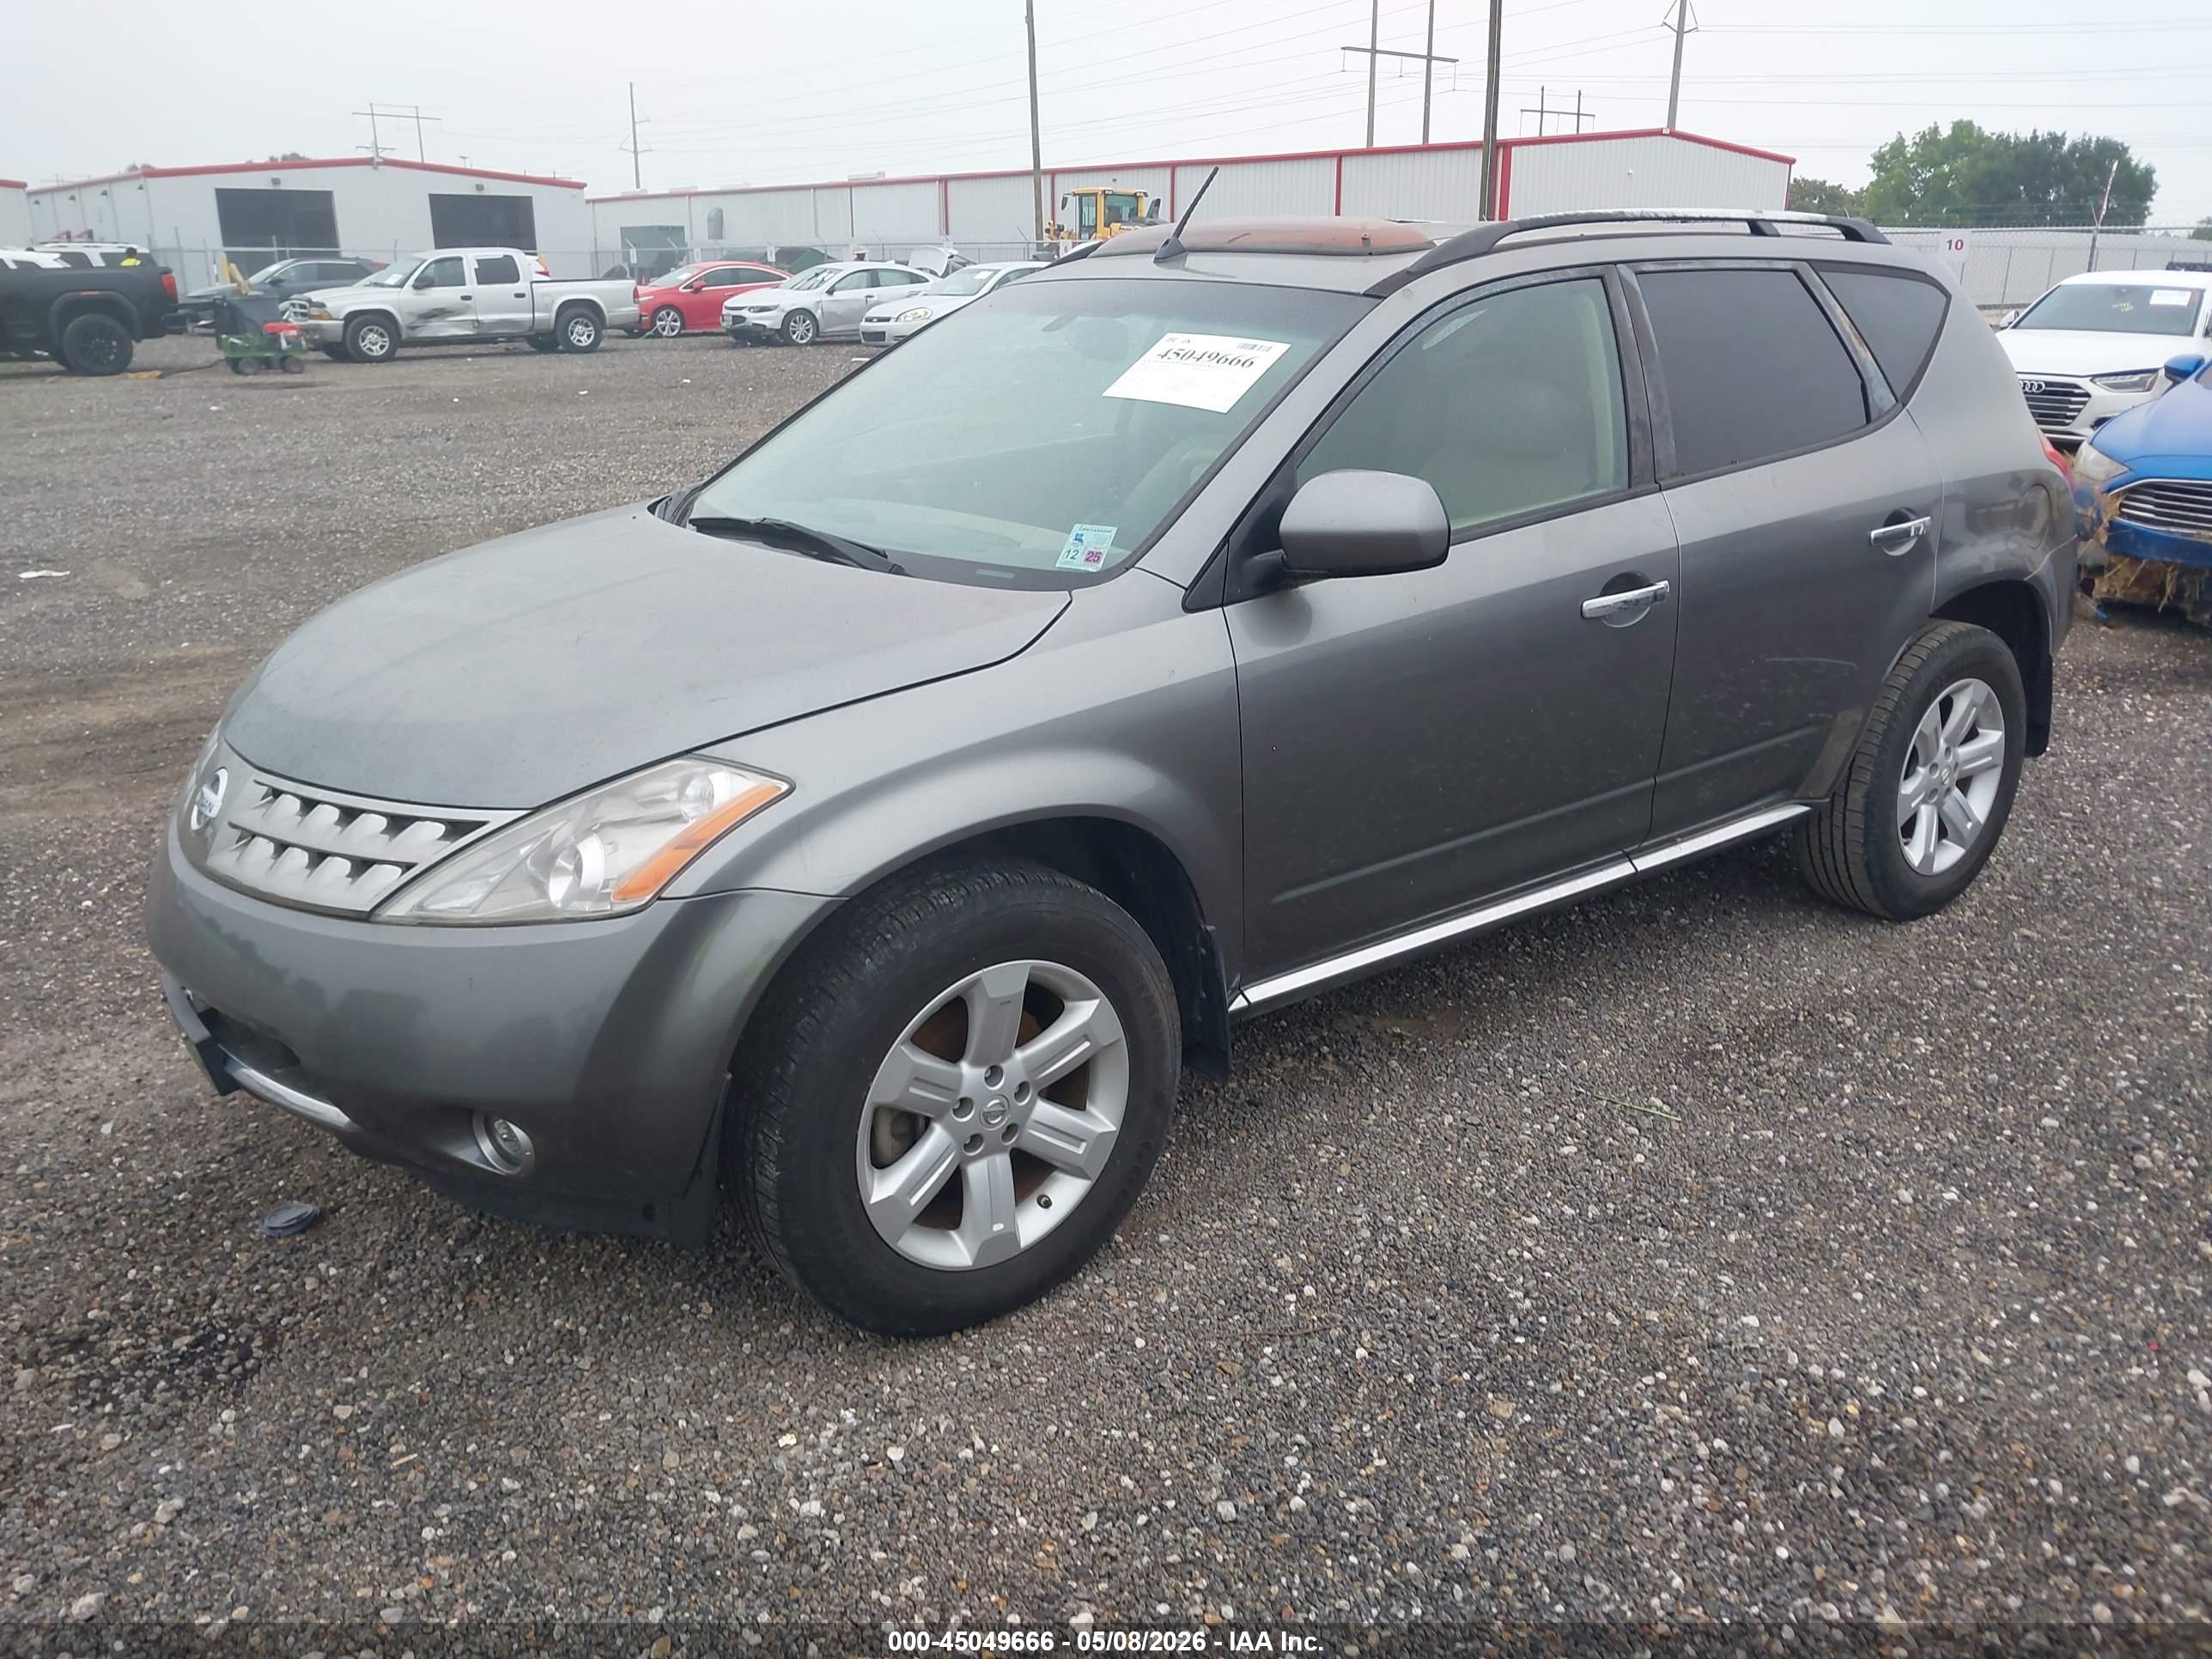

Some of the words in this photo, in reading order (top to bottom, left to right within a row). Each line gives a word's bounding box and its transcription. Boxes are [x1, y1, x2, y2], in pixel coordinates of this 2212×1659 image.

[1947, 239, 1964, 251] 10
[1157, 348, 1259, 368] 45049666
[1065, 549, 1079, 560] 12
[1085, 550, 1103, 563] 25
